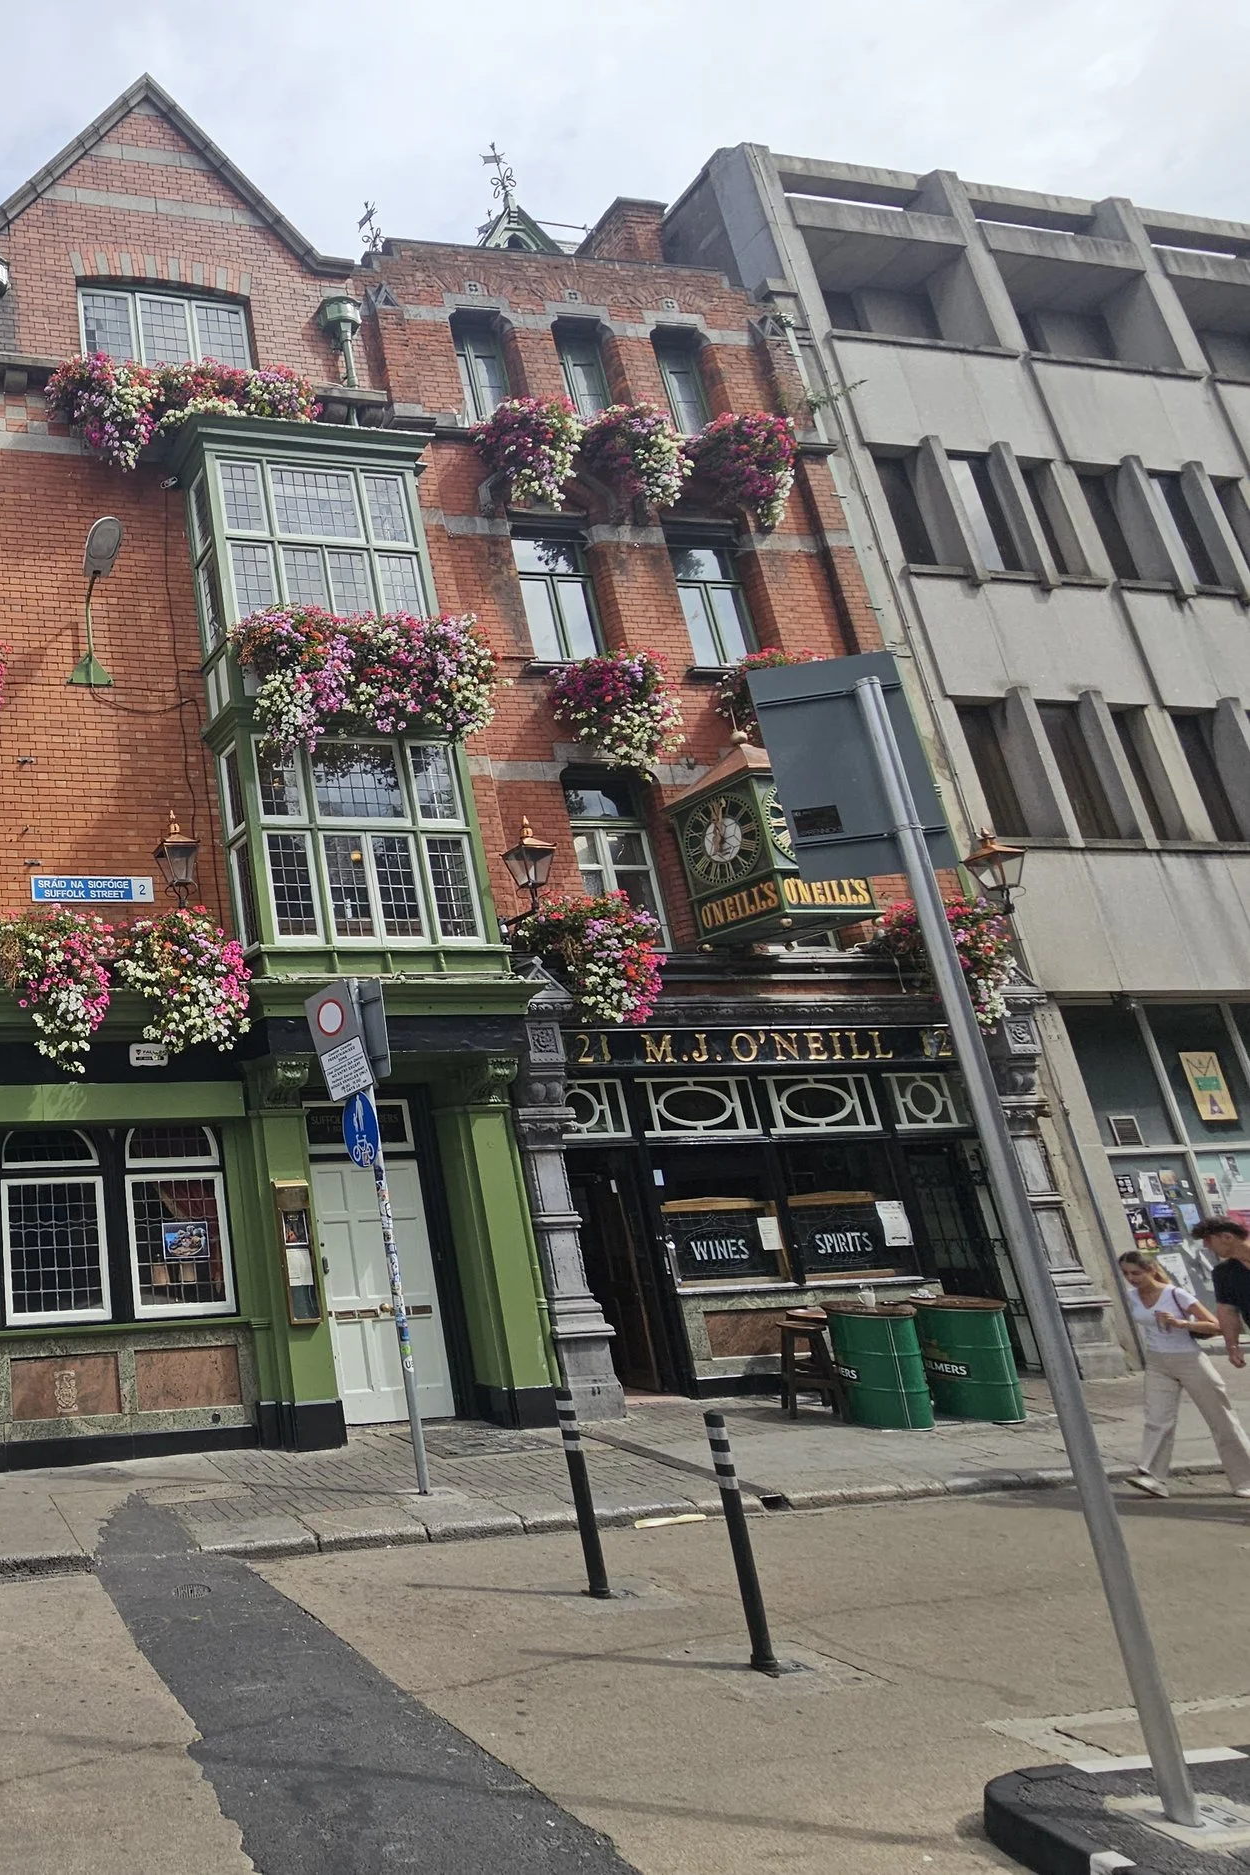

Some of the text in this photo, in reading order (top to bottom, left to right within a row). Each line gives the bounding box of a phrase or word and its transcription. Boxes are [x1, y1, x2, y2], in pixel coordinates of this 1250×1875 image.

[38, 878, 66, 888] SRÁID
[70, 880, 84, 888] NA
[138, 884, 146, 895] 2
[44, 889, 125, 898] SUFFOLK STREET
[783, 877, 871, 906] O'NEILL'S
[701, 881, 779, 929] O'NEILL'S
[690, 1238, 750, 1261] WINES
[814, 1232, 873, 1254] SPIRITS
